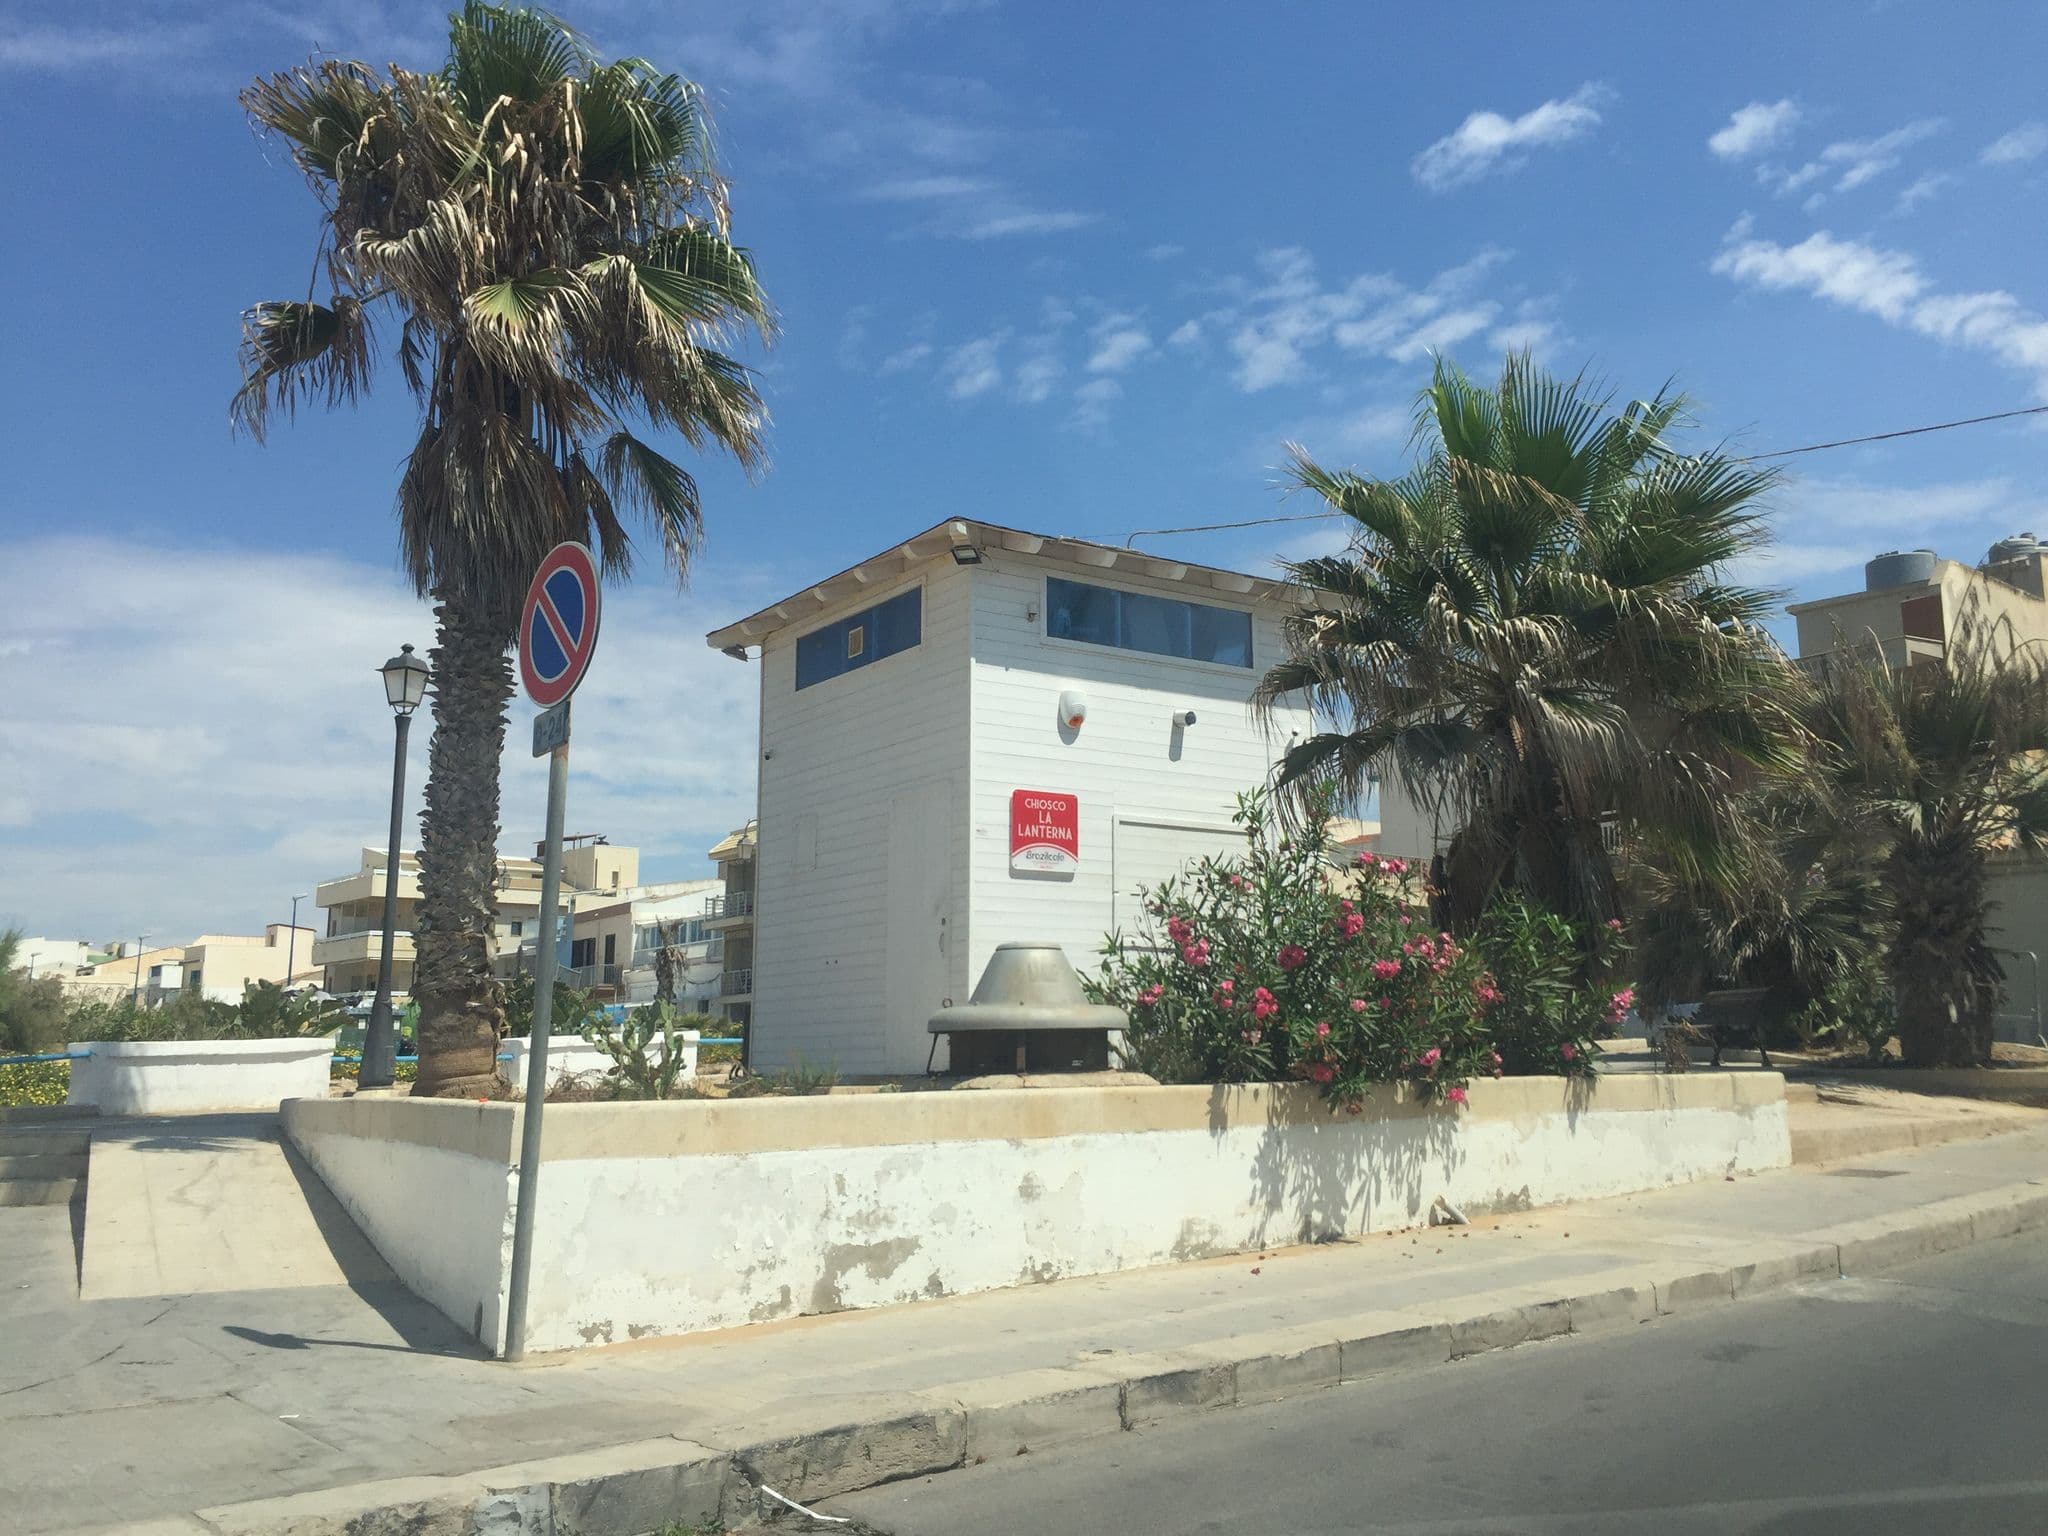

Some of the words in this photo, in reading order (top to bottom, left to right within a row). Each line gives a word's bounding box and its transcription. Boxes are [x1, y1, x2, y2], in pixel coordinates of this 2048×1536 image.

[1024, 798, 1067, 811] CHIOSCO
[1038, 810, 1053, 824] LA
[1017, 823, 1073, 840] LANTERNA
